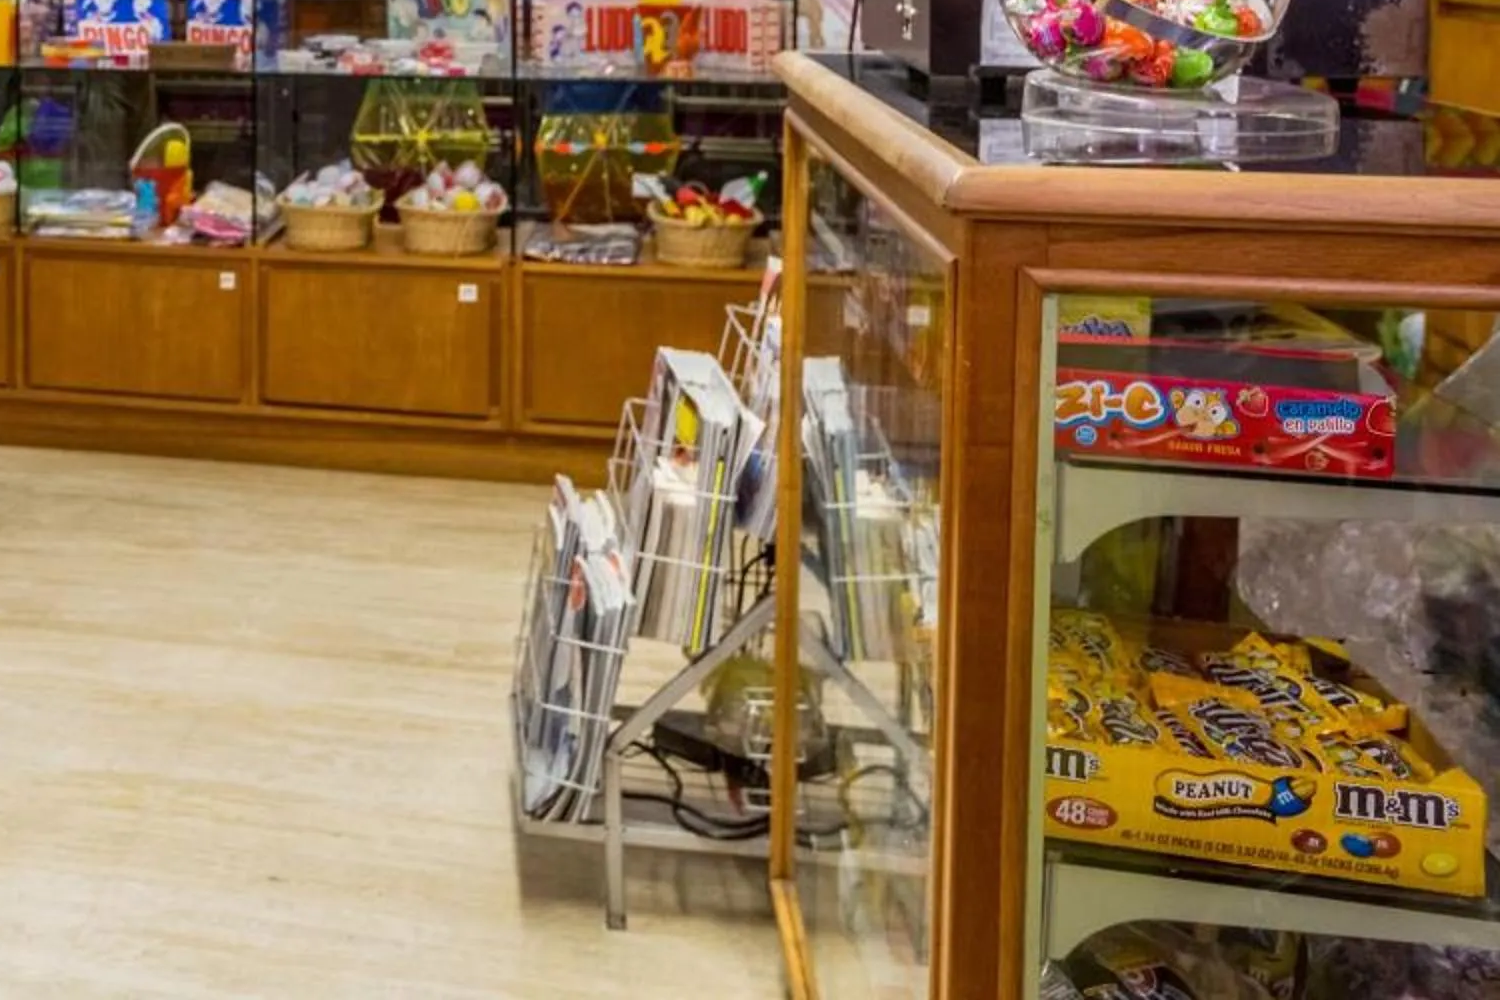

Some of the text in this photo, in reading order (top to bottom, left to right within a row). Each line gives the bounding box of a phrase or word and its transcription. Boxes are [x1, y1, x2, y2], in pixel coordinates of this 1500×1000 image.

[1174, 779, 1252, 799] PEANUT
[1055, 799, 1086, 826] 48
[1336, 783, 1460, 827] m&m's
